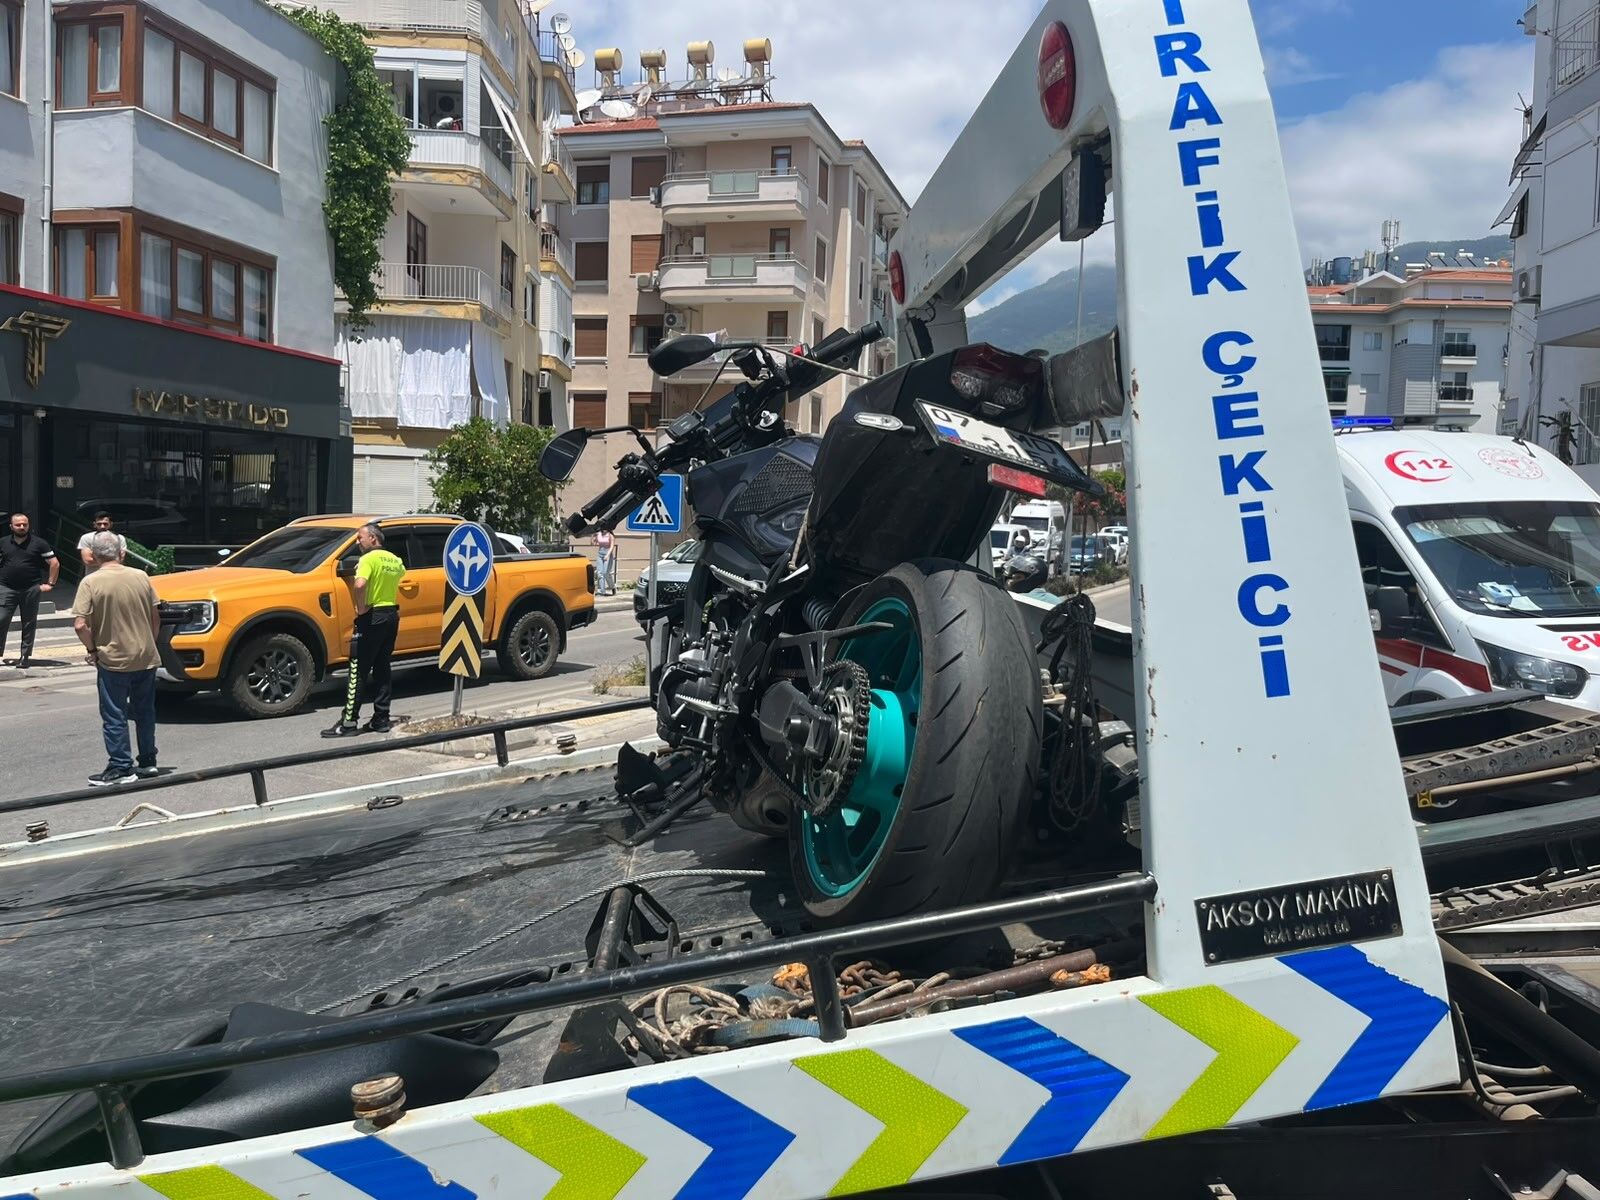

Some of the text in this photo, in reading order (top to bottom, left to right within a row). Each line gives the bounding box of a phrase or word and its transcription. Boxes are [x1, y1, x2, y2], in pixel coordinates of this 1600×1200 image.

[1402, 458, 1453, 472] 112
[1202, 331, 1291, 698] ÇEKİCİ
[1207, 880, 1389, 931] AKSOY MAKİNA
